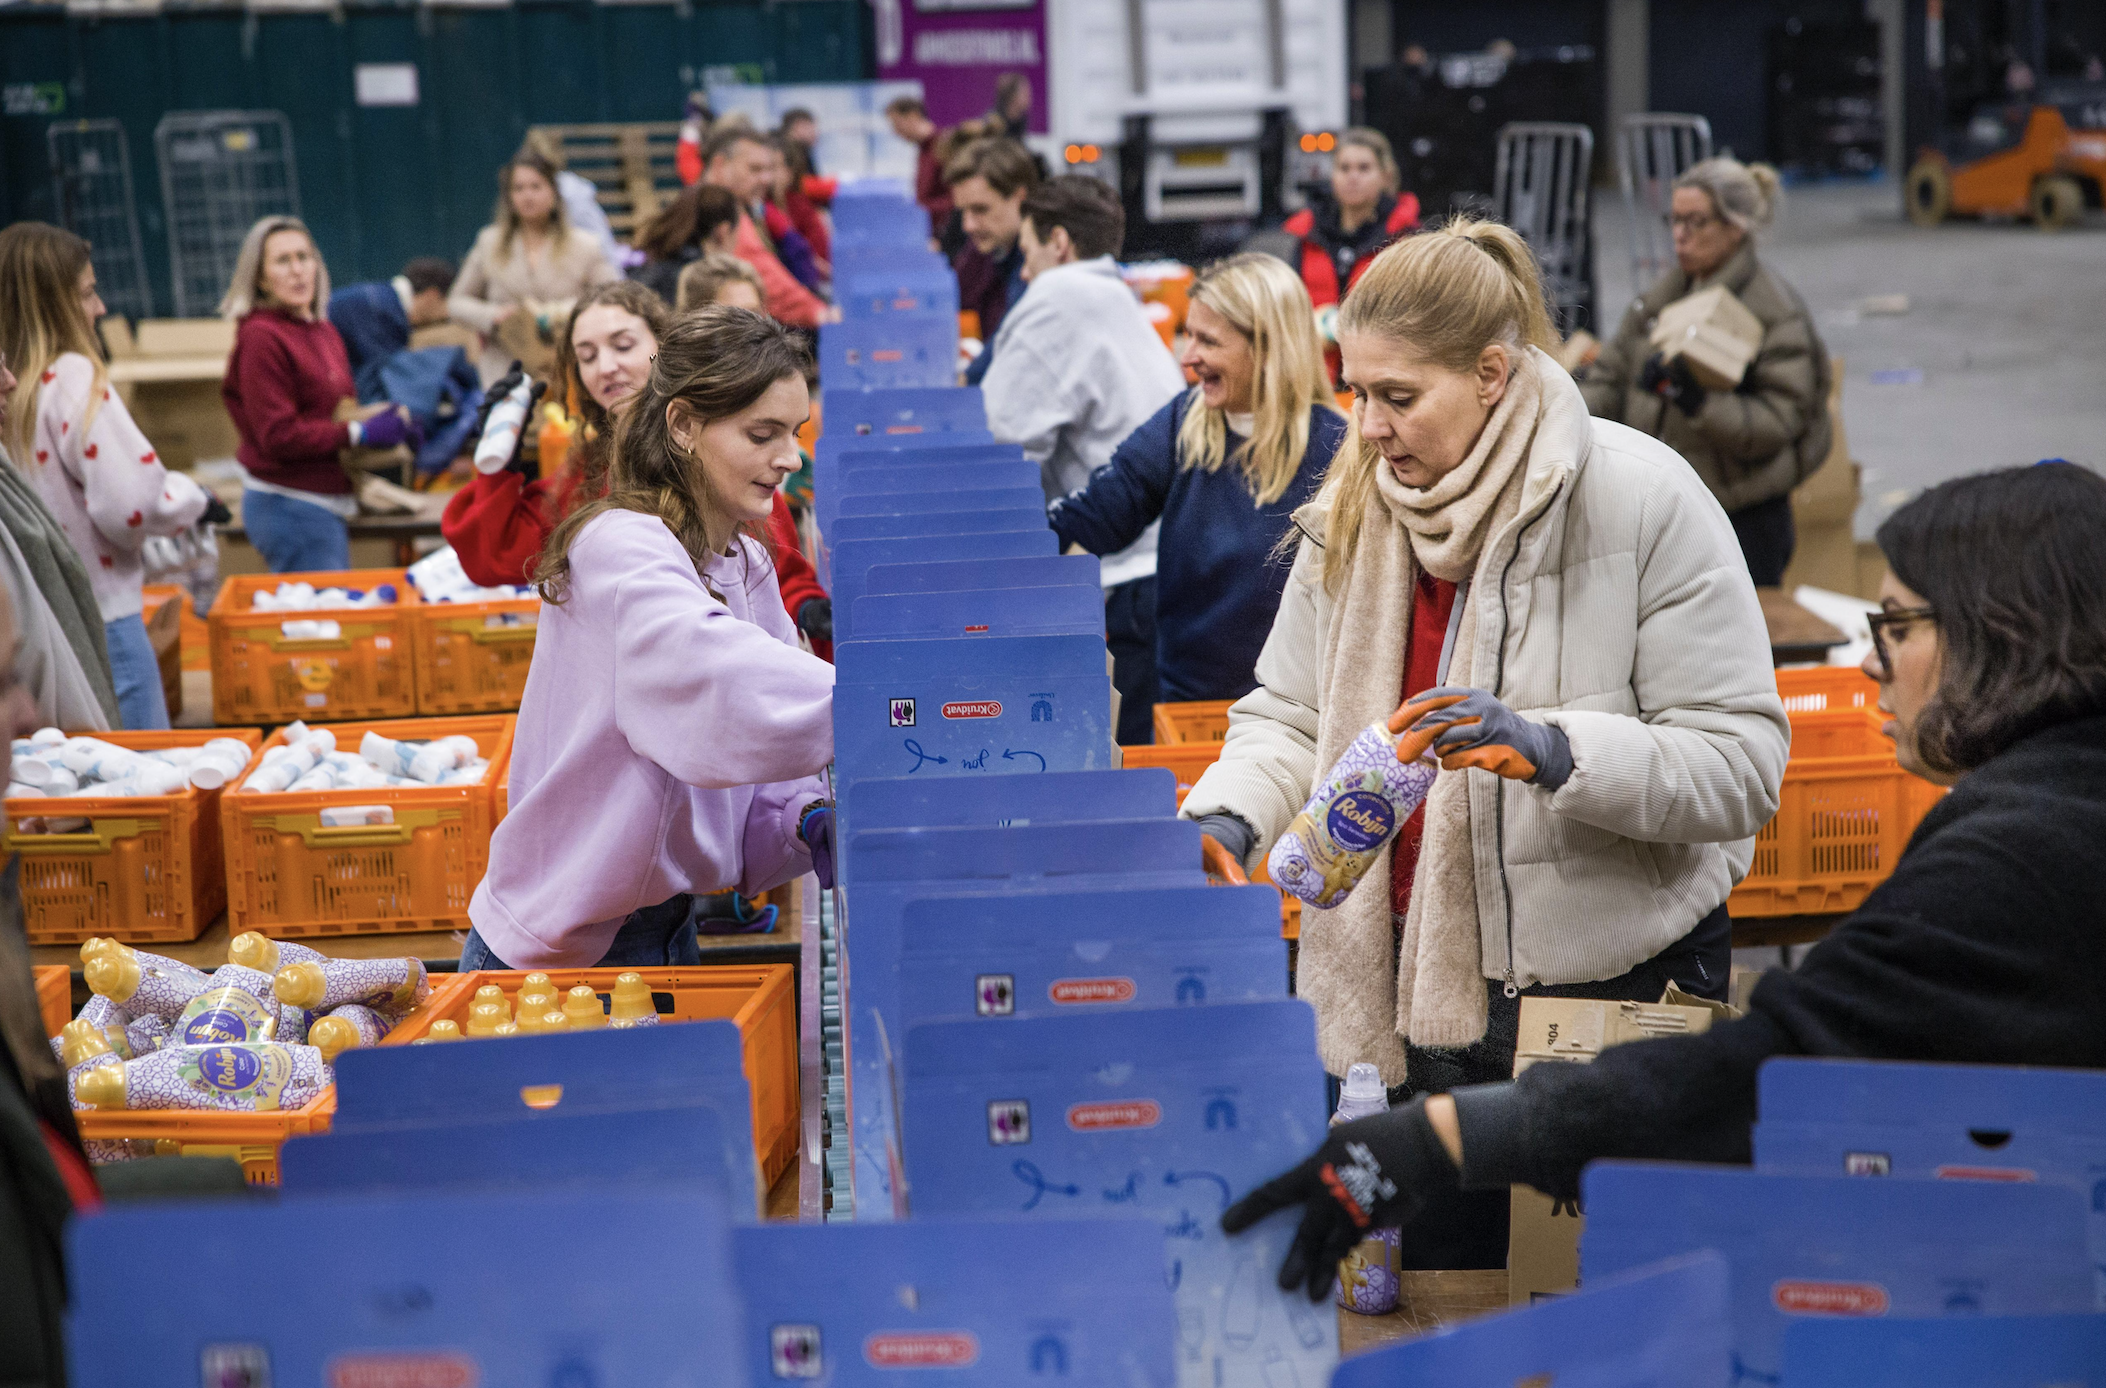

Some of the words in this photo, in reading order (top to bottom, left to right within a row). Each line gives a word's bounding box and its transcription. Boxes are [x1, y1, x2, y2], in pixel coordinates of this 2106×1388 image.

[946, 704, 988, 716] Kruidvat
[1334, 797, 1388, 837] Robijn
[215, 1048, 237, 1088] Robijn
